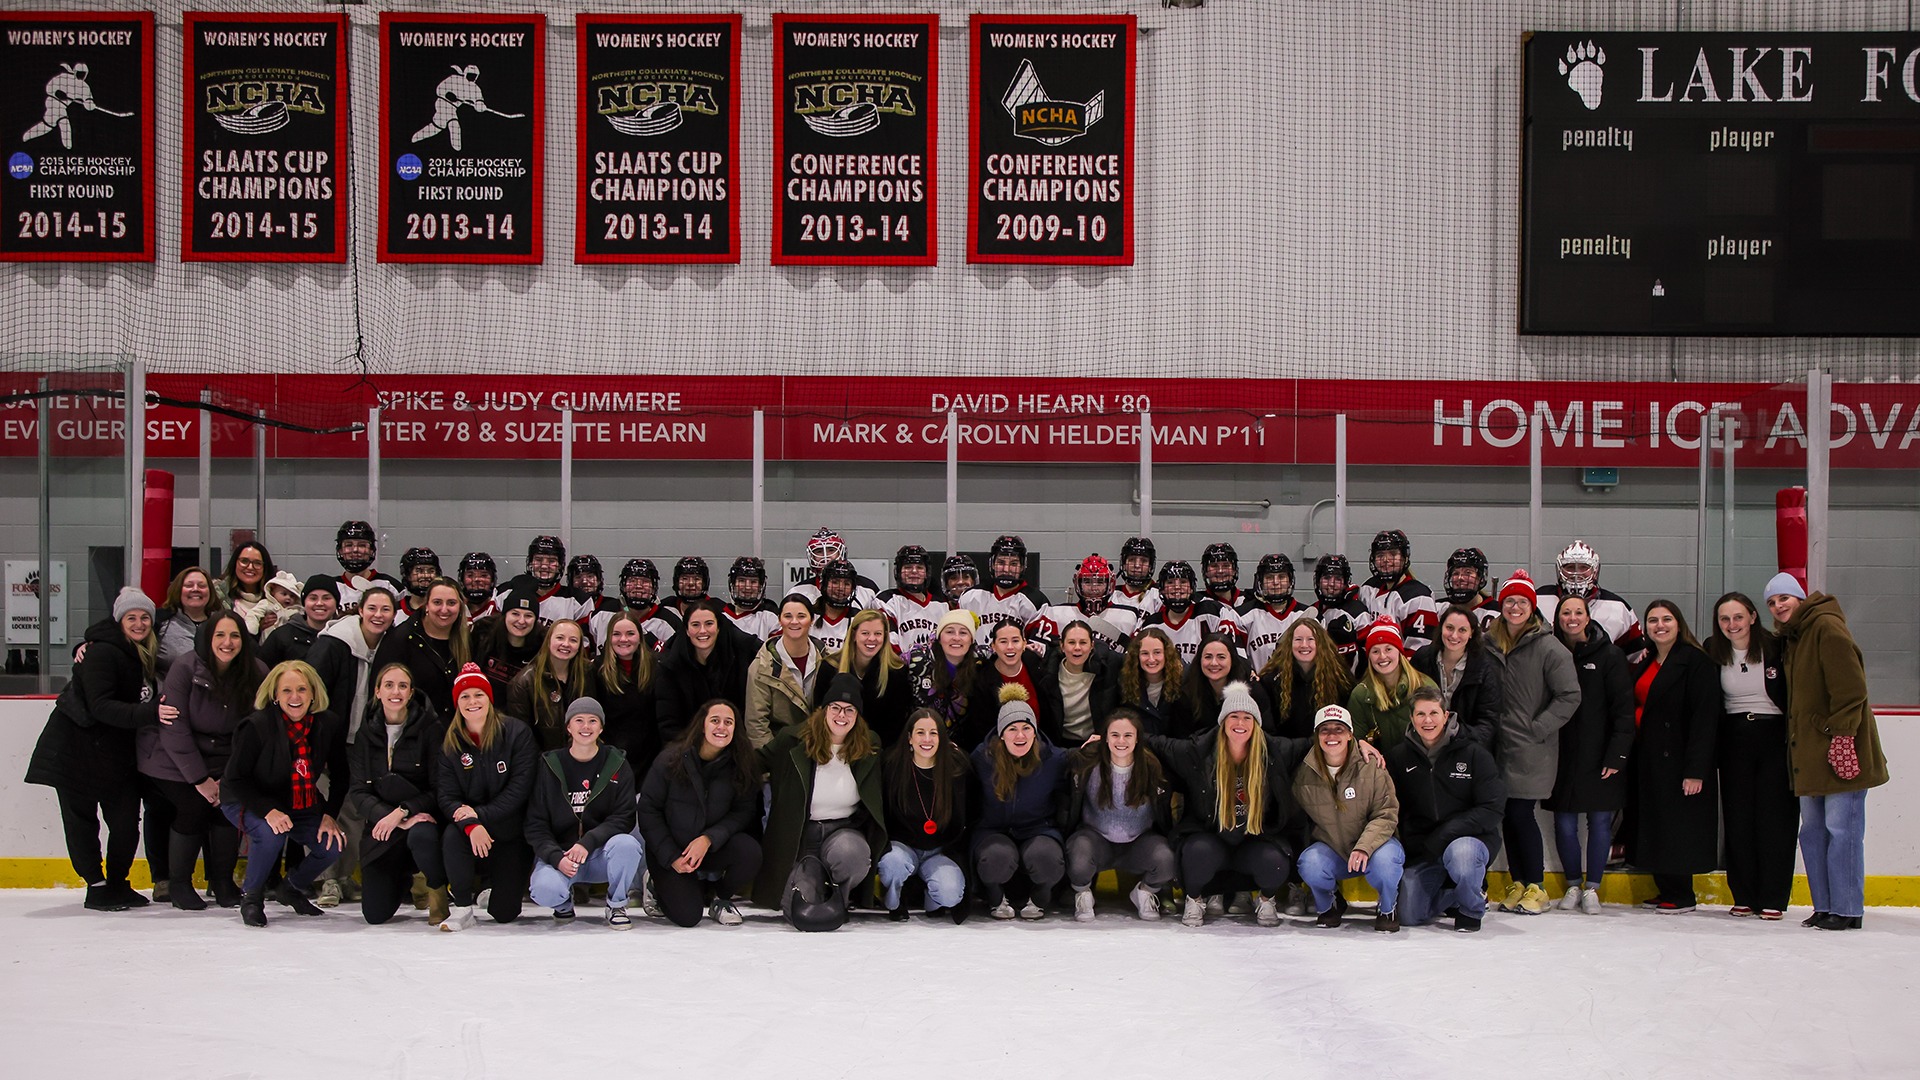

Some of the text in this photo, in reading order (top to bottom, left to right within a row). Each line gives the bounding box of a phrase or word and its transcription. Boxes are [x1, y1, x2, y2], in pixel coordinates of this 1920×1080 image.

[7, 30, 132, 46] WOMEN'S HOCKEY
[203, 31, 328, 47] WOMEN'S HOCKEY
[399, 32, 525, 48] WOMEN'S HOCKEY
[596, 32, 722, 48] WOMEN'S HOCKEY
[792, 32, 919, 48] WOMEN'S HOCKEY
[990, 33, 1117, 49] WOMEN'S HOCKEY
[1636, 47, 1814, 103] LAKE
[206, 81, 326, 114] NCHA
[598, 82, 719, 115] NCHA
[794, 82, 916, 116] NCHA
[1022, 107, 1078, 125] NCHA
[1562, 126, 1633, 152] penalty
[1710, 126, 1775, 152] player
[39, 156, 131, 166] 2015 ICE HOCKEY
[39, 165, 136, 176] CHAMPIONSHIP
[203, 149, 329, 174] SLAATS CUP
[428, 157, 522, 169] 2014 ICE HOCKEY
[428, 167, 527, 178] CHAMPIONSHIP
[595, 151, 722, 175] SLAATS CUP
[790, 153, 921, 176] CONFERENCE
[986, 153, 1119, 176] CONFERENCE
[30, 184, 114, 199] FIRST ROUND
[198, 176, 333, 200] CHAMPIONS
[418, 185, 504, 201] FIRST ROUND
[590, 177, 727, 201] CHAMPIONS
[787, 177, 924, 203] CHAMPIONS
[982, 177, 1121, 203] CHAMPIONS
[18, 211, 126, 239] 2014-15
[210, 211, 318, 239] 2014-15
[406, 213, 514, 240] 2013-14
[604, 213, 713, 240] 2013-14
[800, 214, 910, 242] 2013-14
[996, 213, 1106, 242] 2009-10
[1560, 234, 1631, 260] penalty
[1707, 235, 1772, 260] player
[4, 389, 161, 409] JAET FIED
[377, 391, 681, 412] SPIKE & JUDY GUMMERE
[931, 393, 1151, 414] DAVID HEARN '80
[4, 420, 193, 440] EV GUERSEY
[352, 421, 706, 443] PTER '78 & SUZETTE HEARN
[813, 422, 888, 444] MARK
[895, 423, 914, 444] &
[1049, 424, 1207, 446] HELDERMAN
[1432, 398, 1626, 449] HOME
[1650, 400, 1743, 450] ICE
[1035, 619, 1052, 642] 12
[1412, 614, 1425, 634] 4
